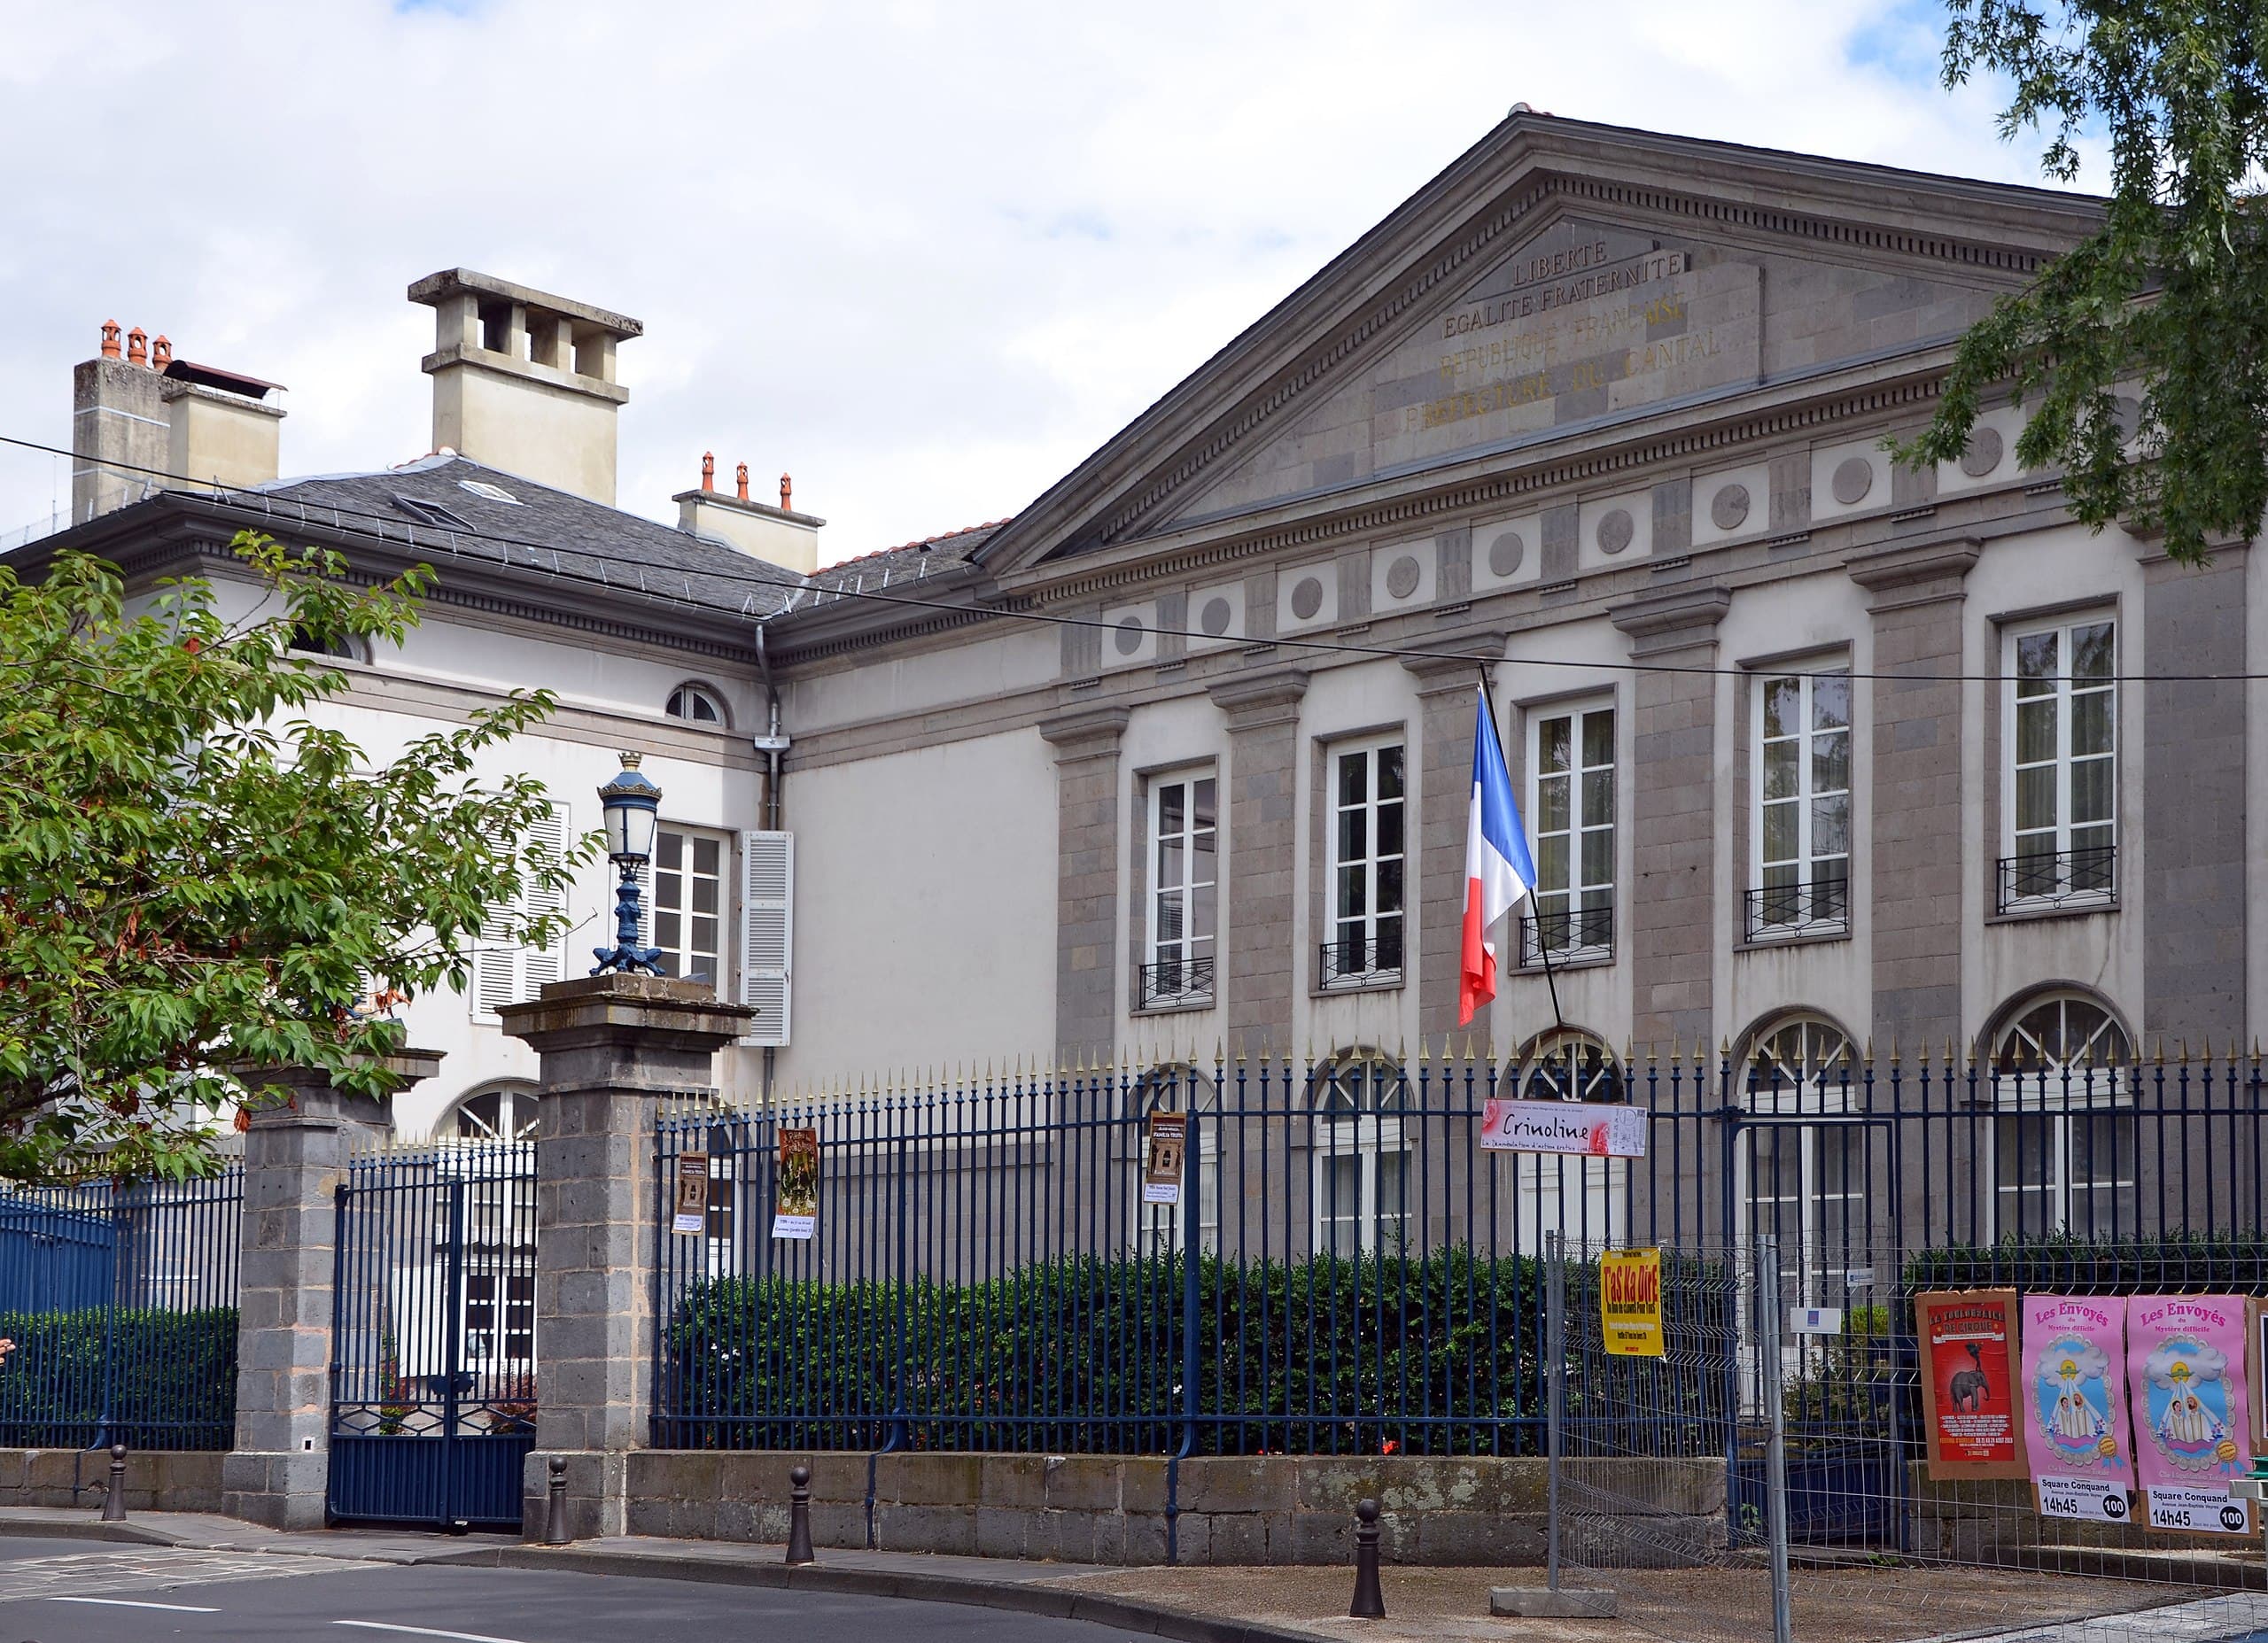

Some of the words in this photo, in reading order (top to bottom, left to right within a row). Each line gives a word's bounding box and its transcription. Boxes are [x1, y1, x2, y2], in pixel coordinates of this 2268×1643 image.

[1513, 240, 1608, 287] LIBERTE
[1442, 296, 1533, 339] EGALITE
[1541, 254, 1682, 311] FRATERNITE
[1573, 361, 1604, 391] DU
[1624, 327, 1721, 376] CANTAL
[1503, 1113, 1588, 1140] Crinoline
[2035, 1308, 2055, 1325] Les
[2058, 1303, 2109, 1327] Envoyés
[2140, 1309, 2163, 1326] Les
[2166, 1303, 2225, 1327] Envoyés
[1957, 1321, 1992, 1333] CIRQUE
[2041, 1479, 2070, 1490] Square
[2070, 1481, 2110, 1492] Conquand
[2043, 1496, 2078, 1514] 14h45
[2104, 1500, 2124, 1513] 100
[2153, 1491, 2182, 1501] Square
[2184, 1492, 2228, 1503] Conquand
[2153, 1508, 2191, 1527] 14h45
[2221, 1512, 2242, 1524] 100
